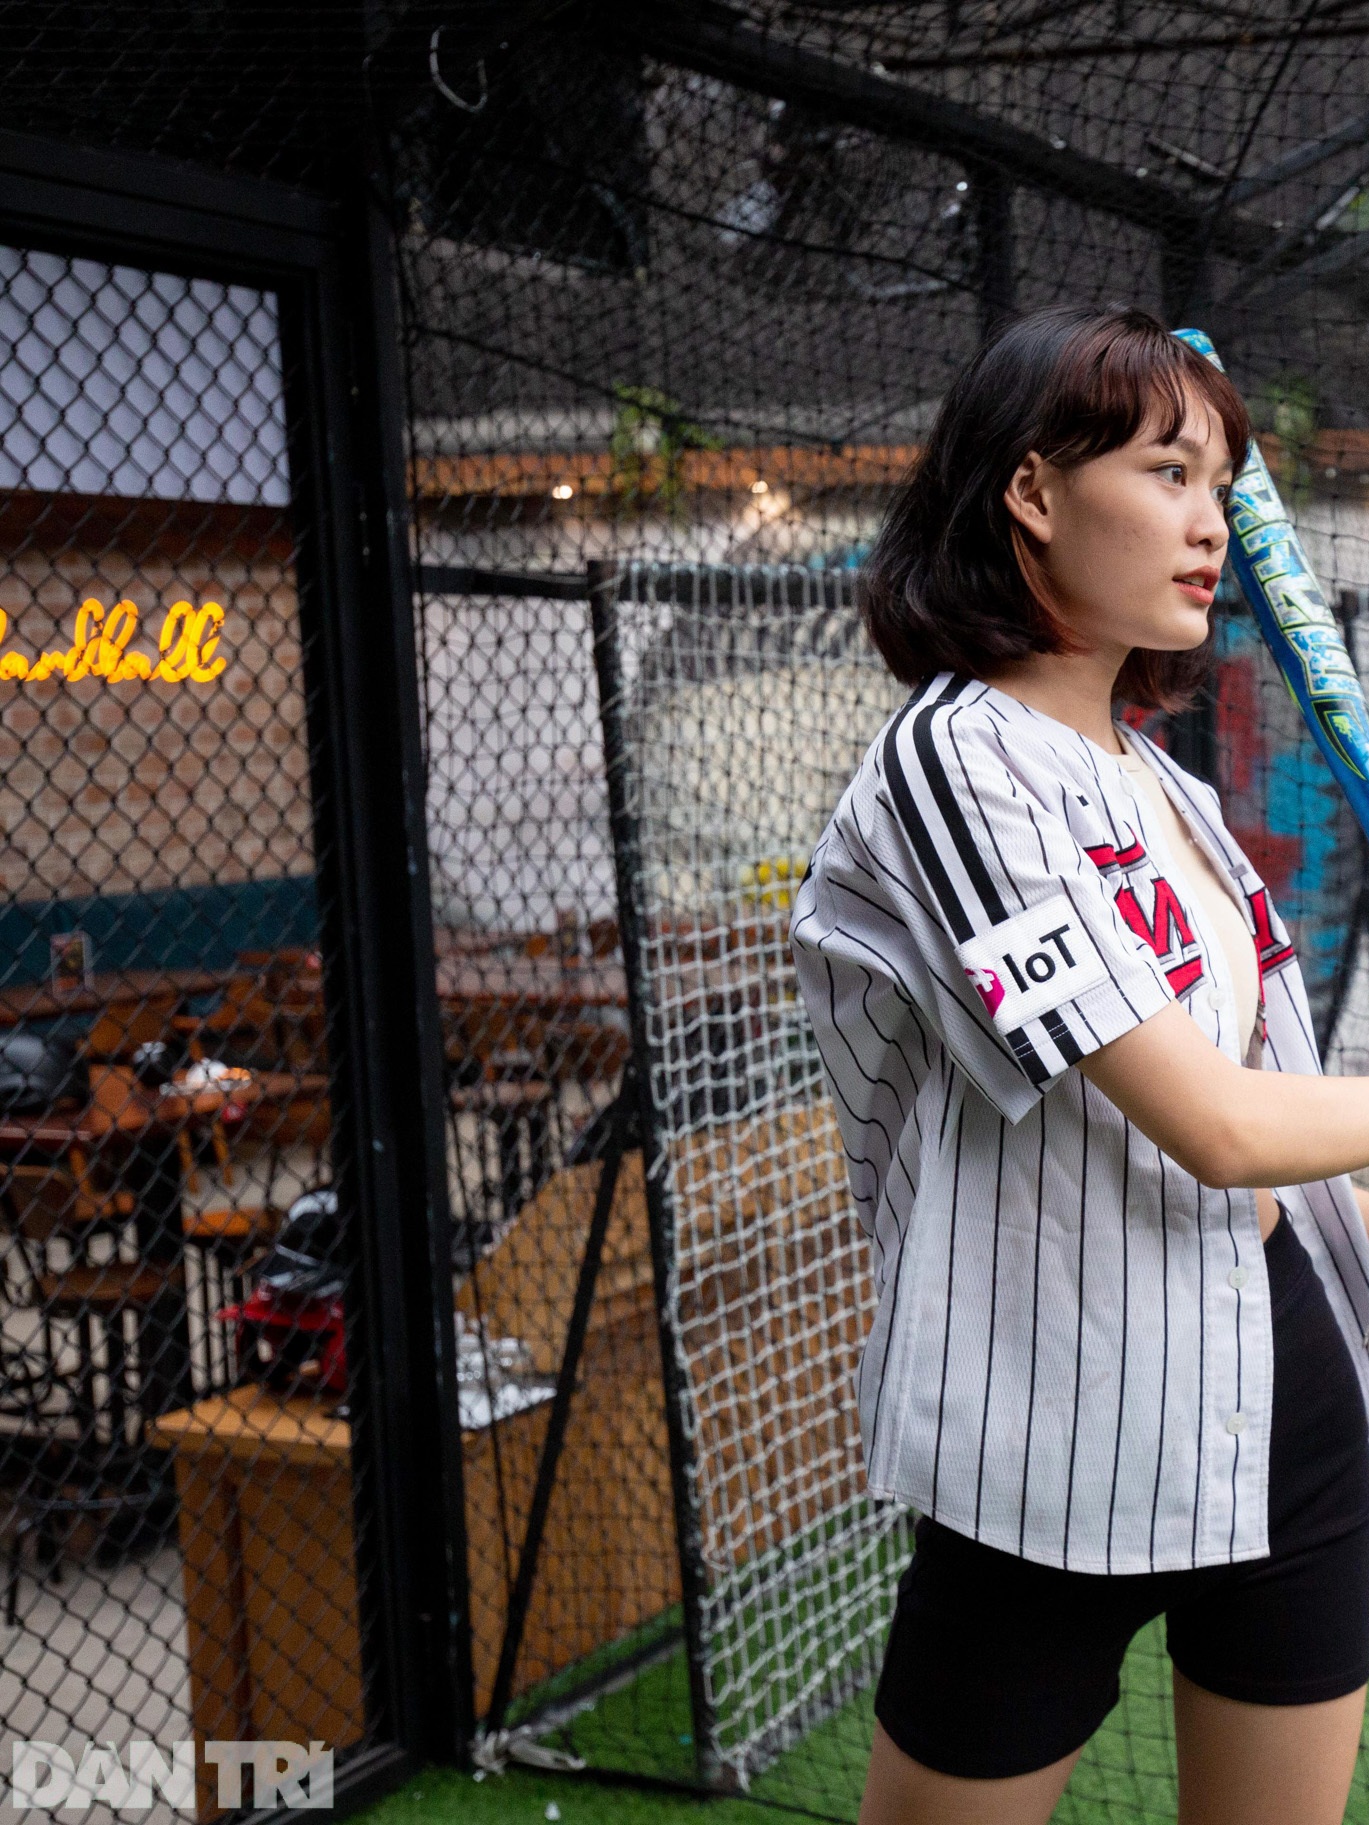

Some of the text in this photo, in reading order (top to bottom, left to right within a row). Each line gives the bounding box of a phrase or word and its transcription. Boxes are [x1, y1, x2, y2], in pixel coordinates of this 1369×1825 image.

[1230, 440, 1362, 695] MAYH
[0, 597, 227, 684] ardball
[1002, 924, 1077, 994] IoT
